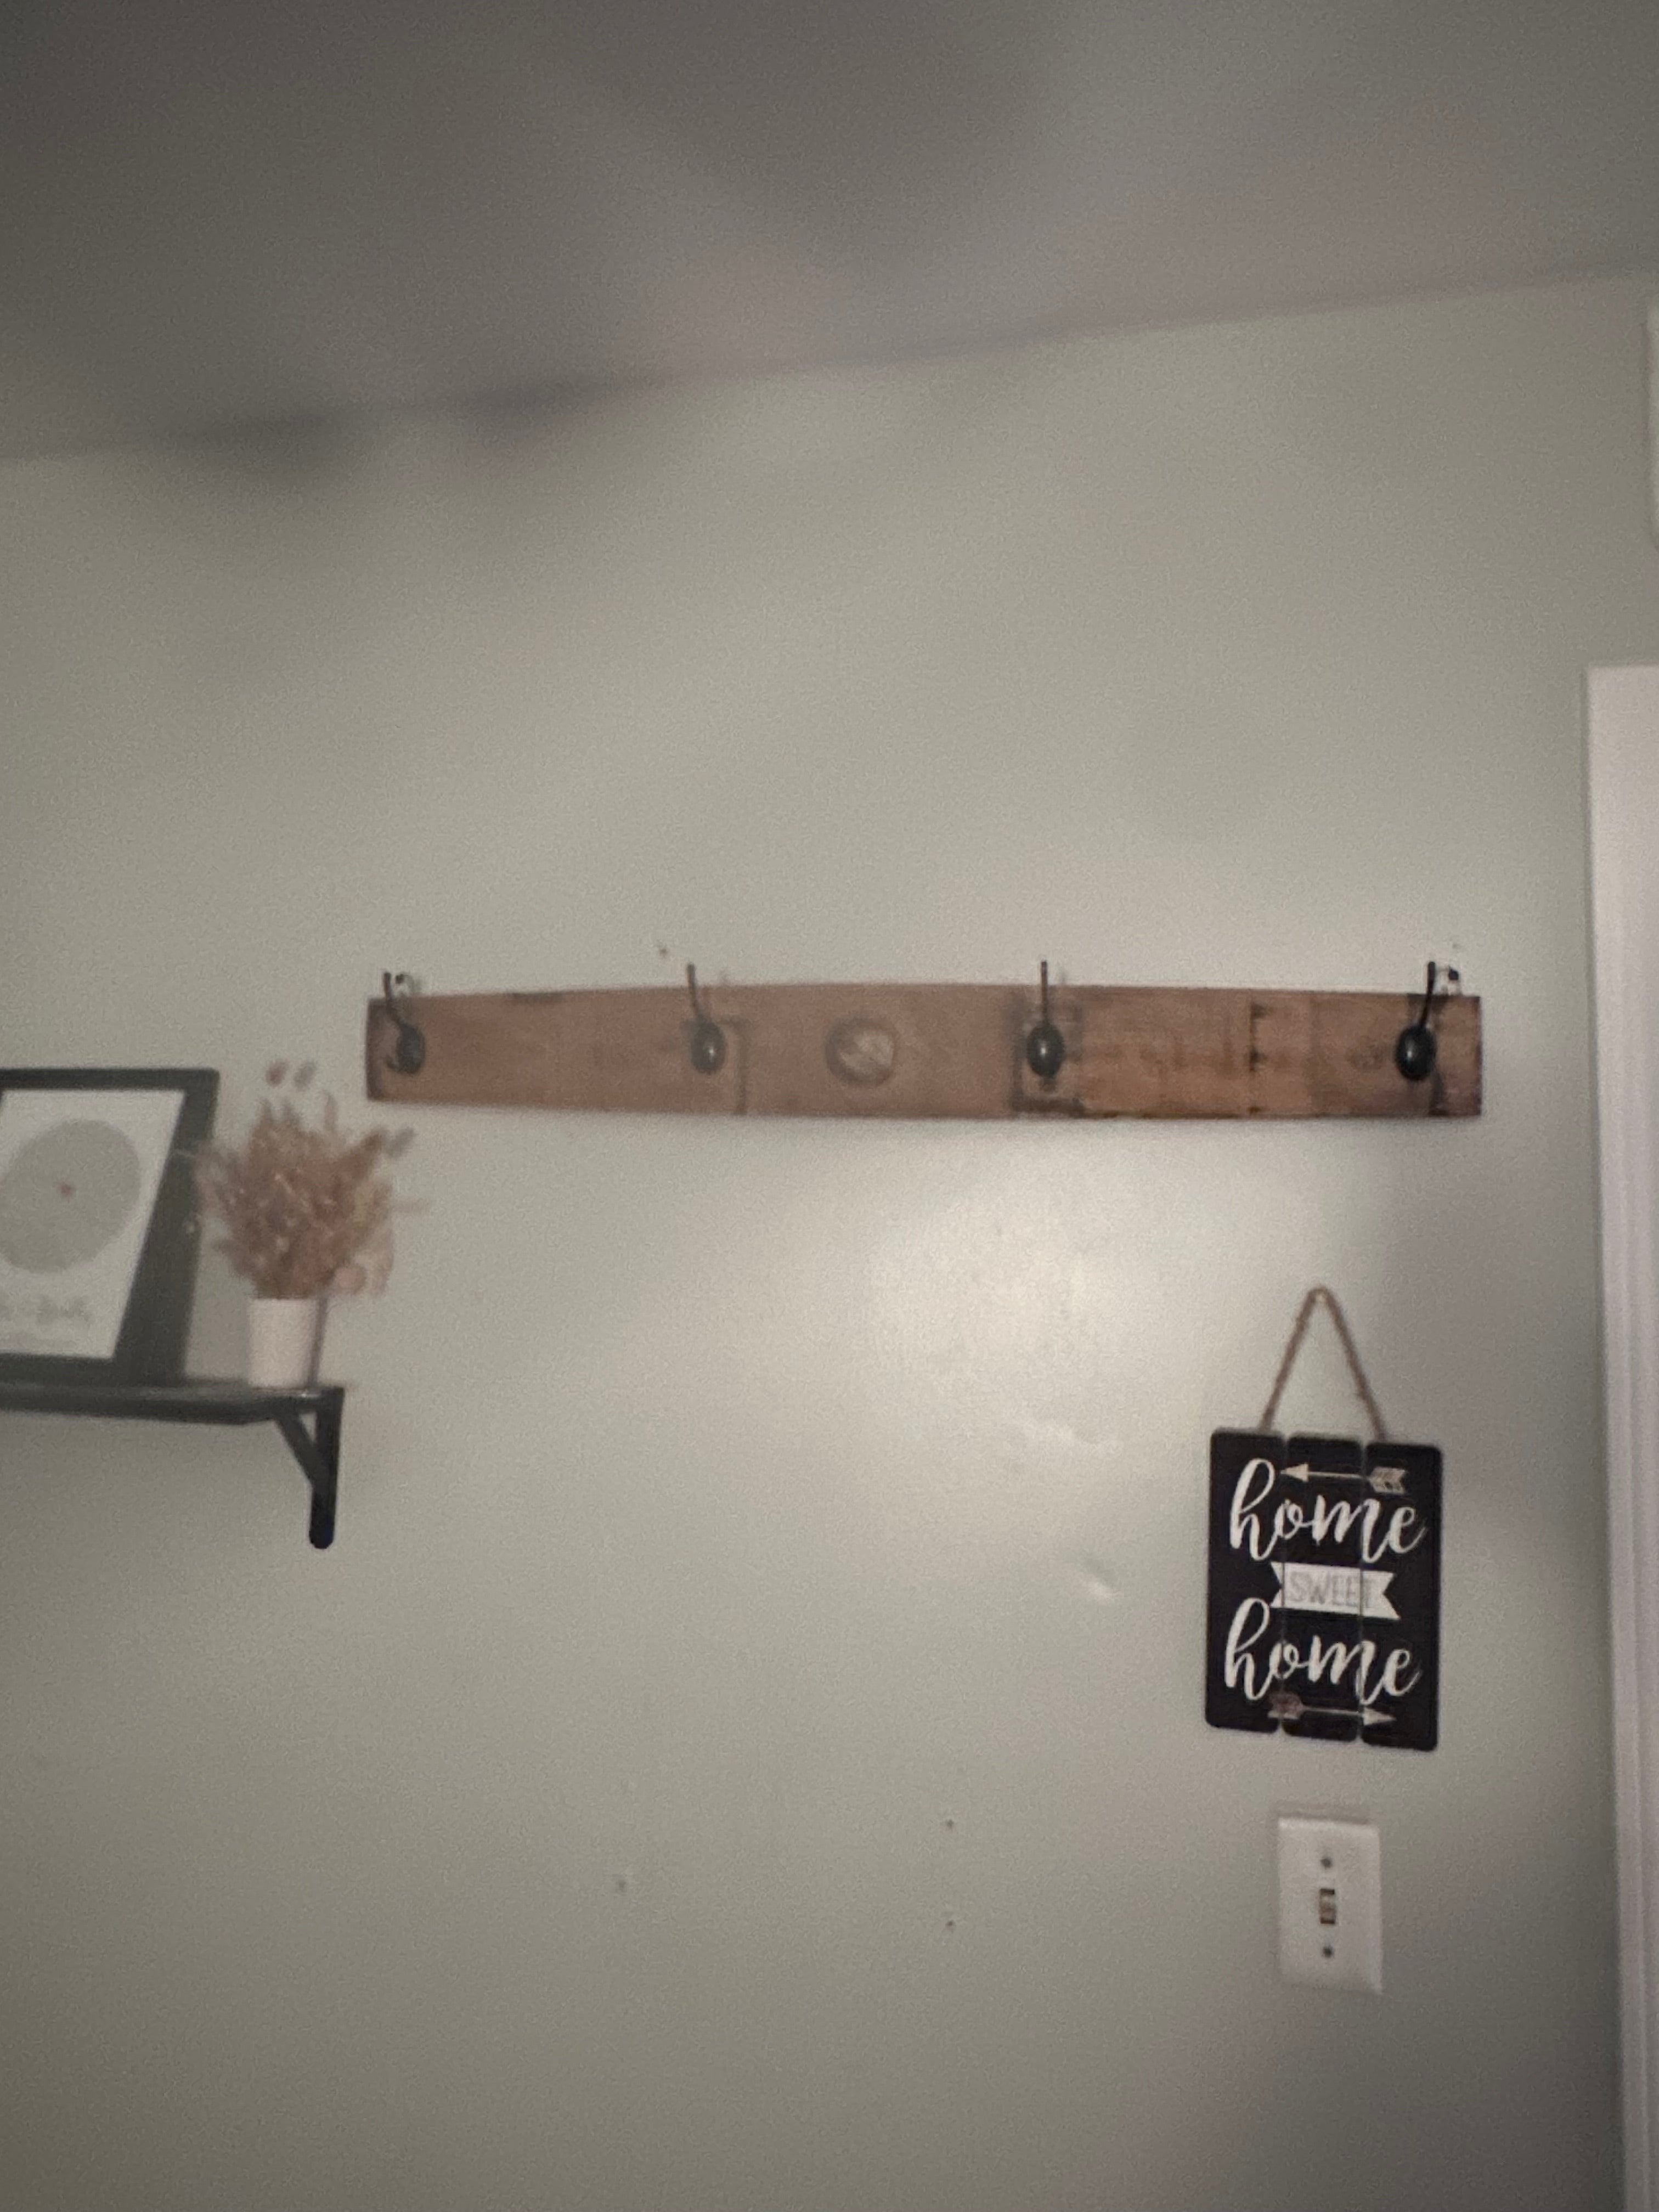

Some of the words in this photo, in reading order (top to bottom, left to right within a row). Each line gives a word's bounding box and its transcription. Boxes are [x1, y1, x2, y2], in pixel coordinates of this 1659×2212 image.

[1229, 1458, 1427, 1562] home
[1289, 1571, 1376, 1609] SWEET
[1224, 1597, 1421, 1705] home
